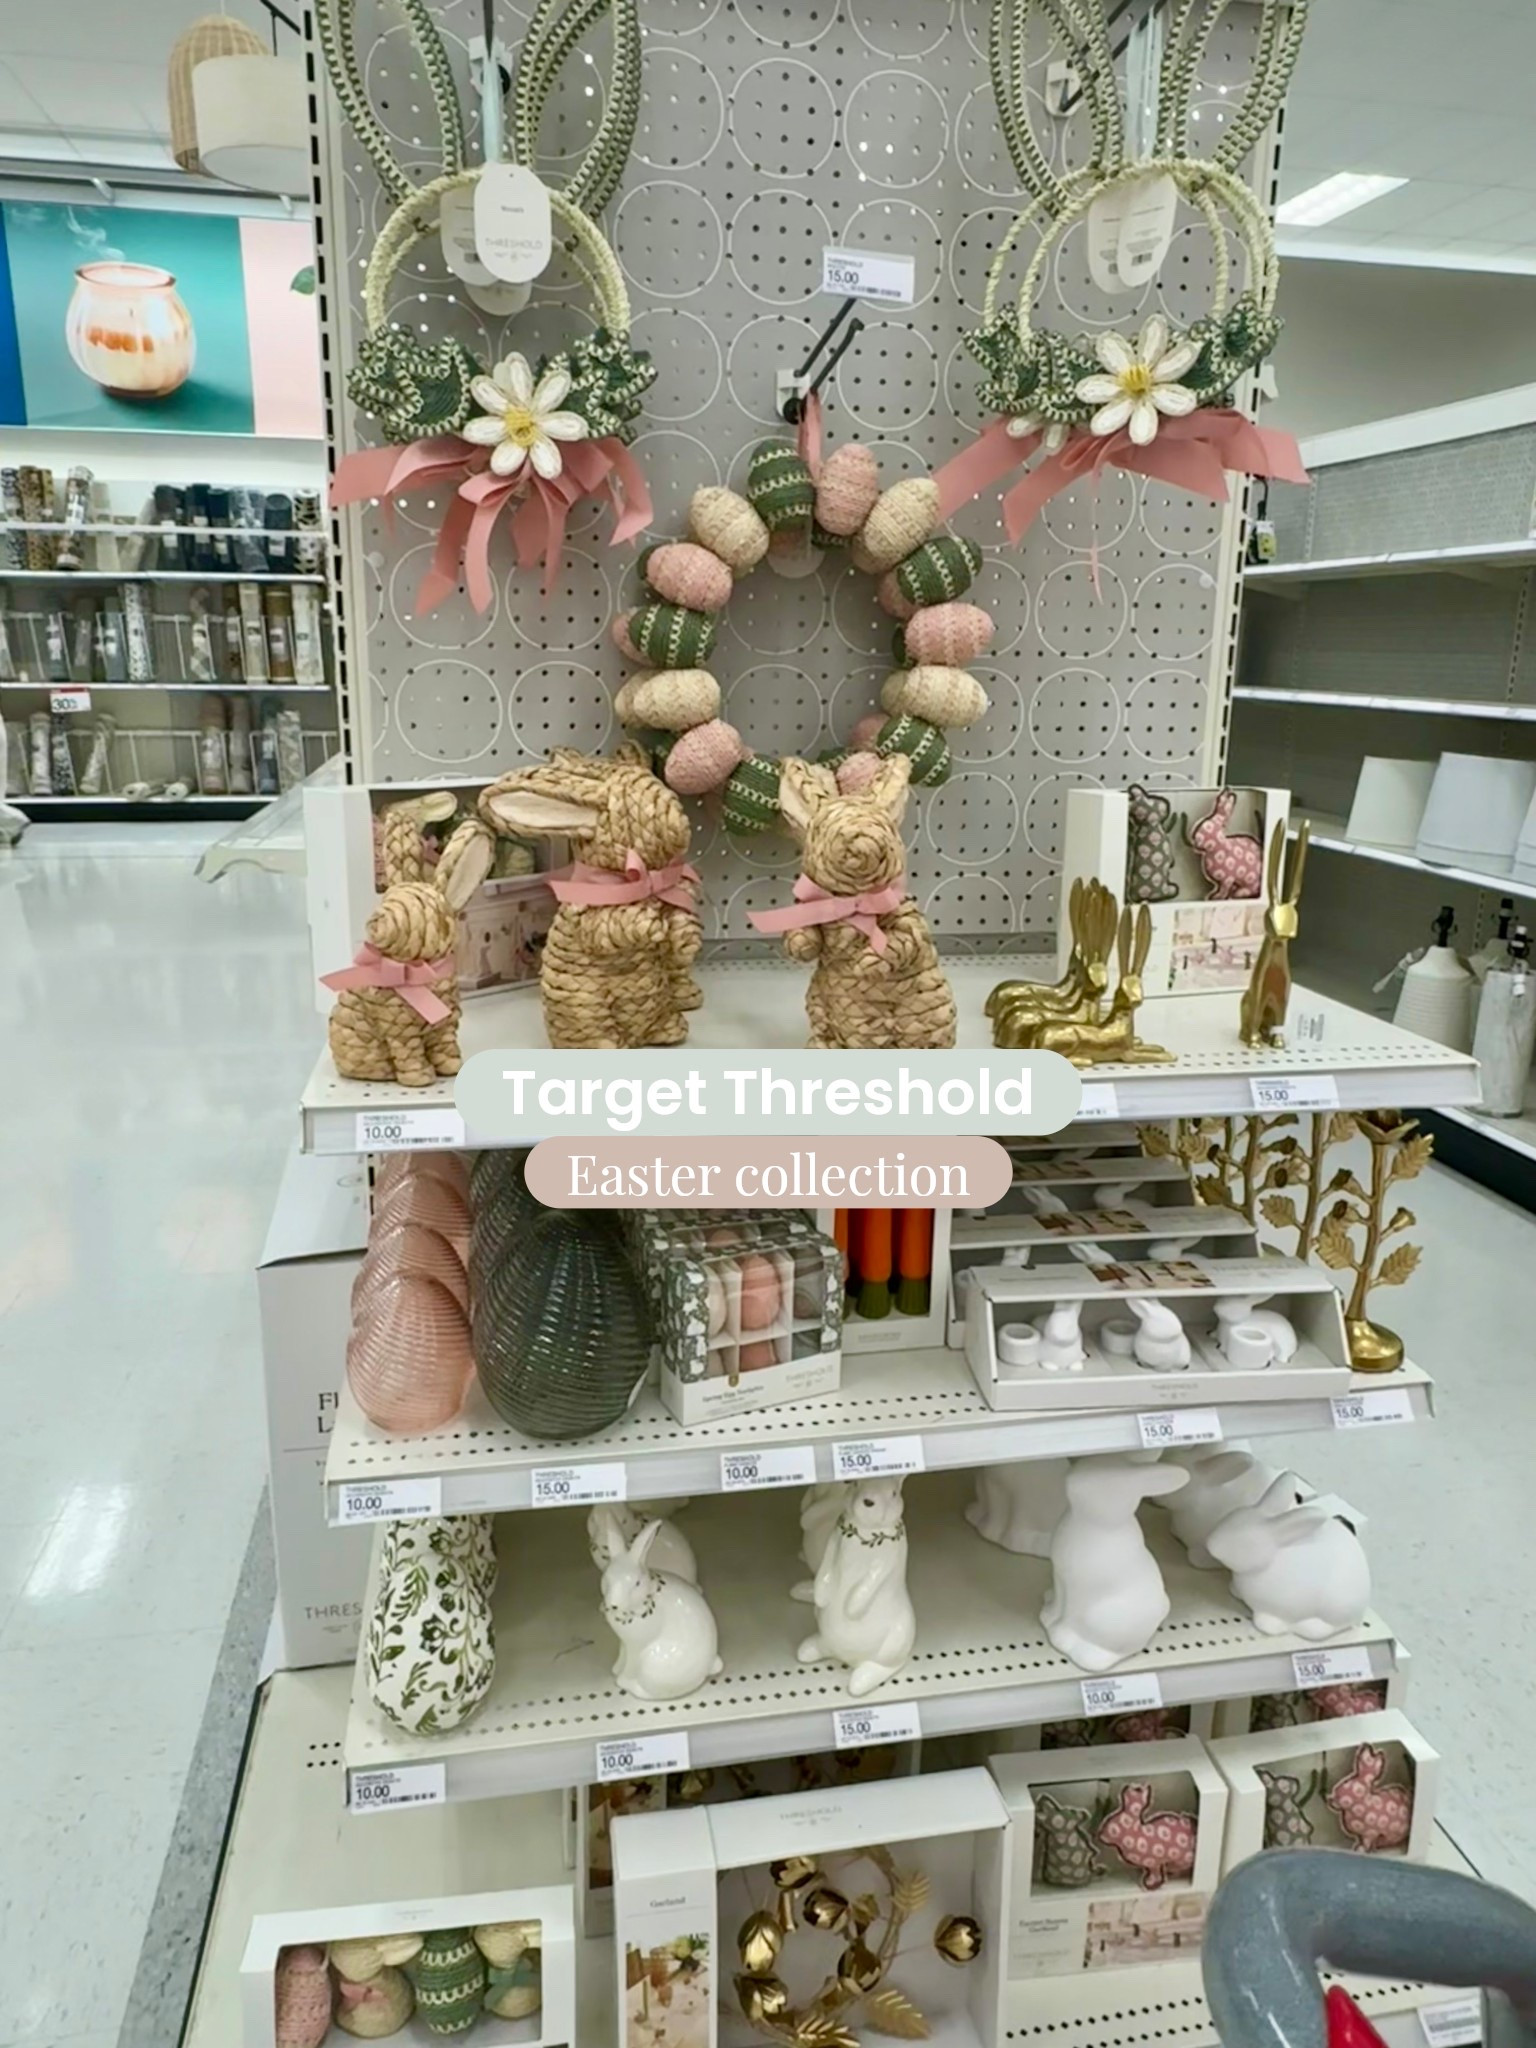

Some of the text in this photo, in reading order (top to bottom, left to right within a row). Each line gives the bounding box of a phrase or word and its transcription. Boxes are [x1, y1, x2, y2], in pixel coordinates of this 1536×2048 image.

[485, 237, 544, 250] THRESHOLD
[827, 270, 860, 285] 15.00
[1258, 1089, 1289, 1102] 15.00
[364, 1125, 402, 1140] 10.00
[1335, 1406, 1364, 1419] 15.00
[1143, 1424, 1174, 1438] 15.00
[840, 1453, 872, 1468] 15.00
[725, 1465, 758, 1480] 10.00
[536, 1481, 570, 1496] 15.00
[347, 1496, 382, 1512] 10.00
[1298, 1663, 1326, 1677] 15.00
[1086, 1690, 1116, 1705] 10.00
[841, 1720, 871, 1736] 15.00
[601, 1753, 634, 1769] 10.00
[356, 1784, 391, 1800] 10.00
